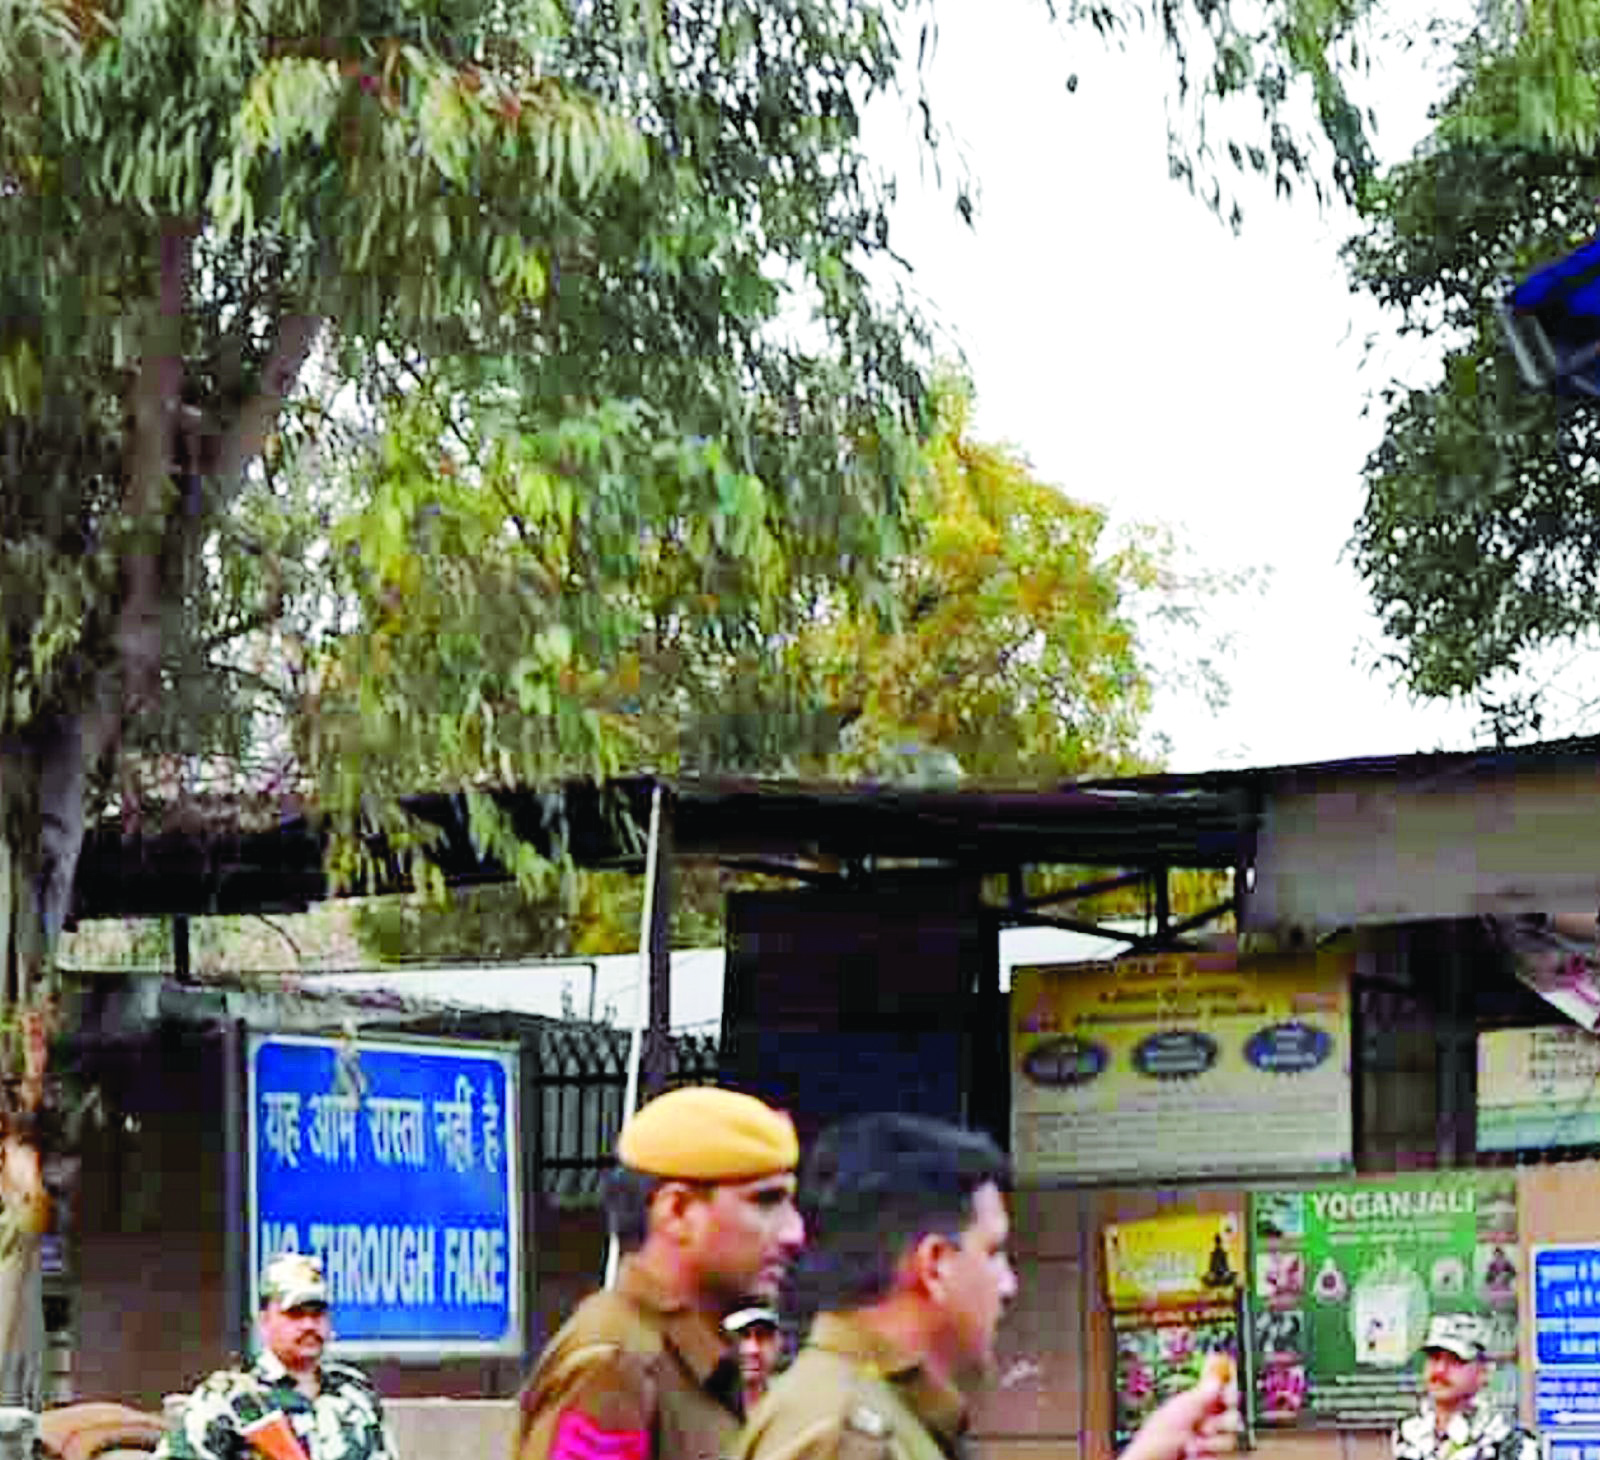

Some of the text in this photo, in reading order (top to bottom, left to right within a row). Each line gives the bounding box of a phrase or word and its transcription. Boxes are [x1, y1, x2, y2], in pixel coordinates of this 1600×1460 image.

[261, 1091, 300, 1170] यह
[365, 1096, 425, 1167] रास्ता
[1313, 1189, 1474, 1220] YOGANJALI
[309, 1222, 435, 1305] THROUGH
[446, 1226, 504, 1306] FARE
